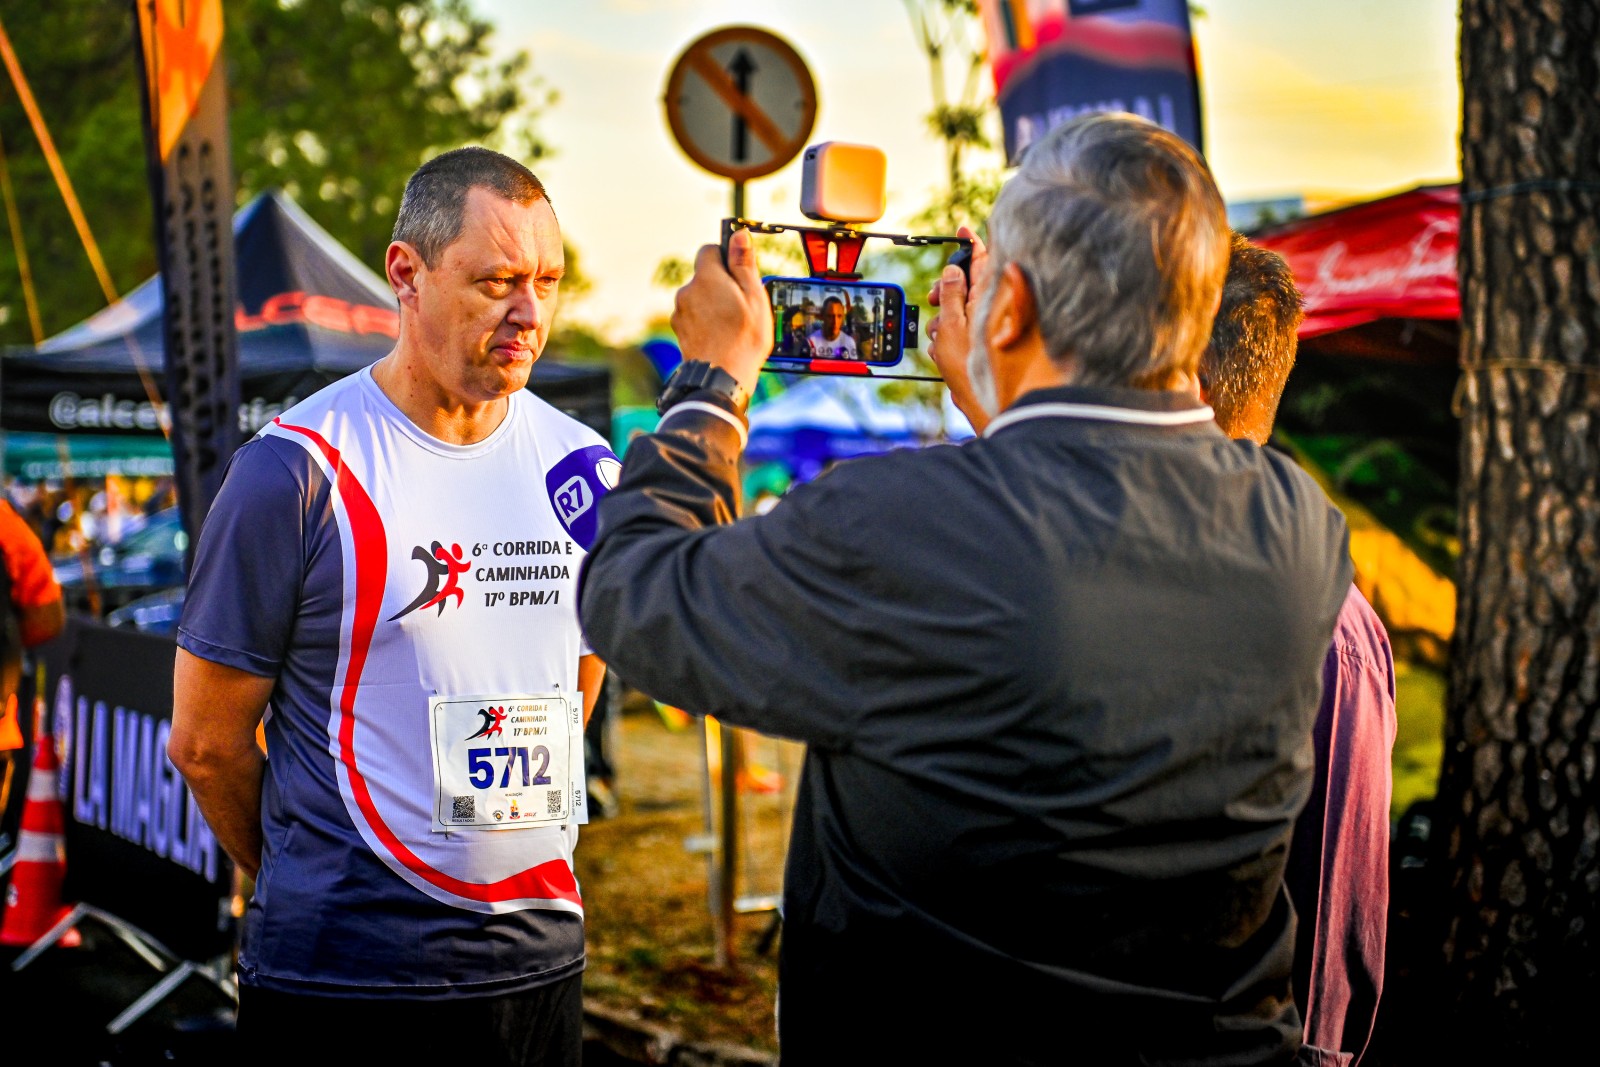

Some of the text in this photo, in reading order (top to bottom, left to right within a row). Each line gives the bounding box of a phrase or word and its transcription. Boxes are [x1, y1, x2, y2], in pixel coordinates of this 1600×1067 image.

[557, 479, 584, 519] R7
[493, 540, 562, 556] CORRIDA
[565, 541, 573, 555] E
[475, 565, 570, 582] CAMINHADA
[509, 589, 560, 607] BPM/I
[517, 704, 543, 712] CORRIDA
[510, 715, 547, 723] CAMINHADA
[73, 695, 109, 831] LA
[467, 744, 552, 790] 5712
